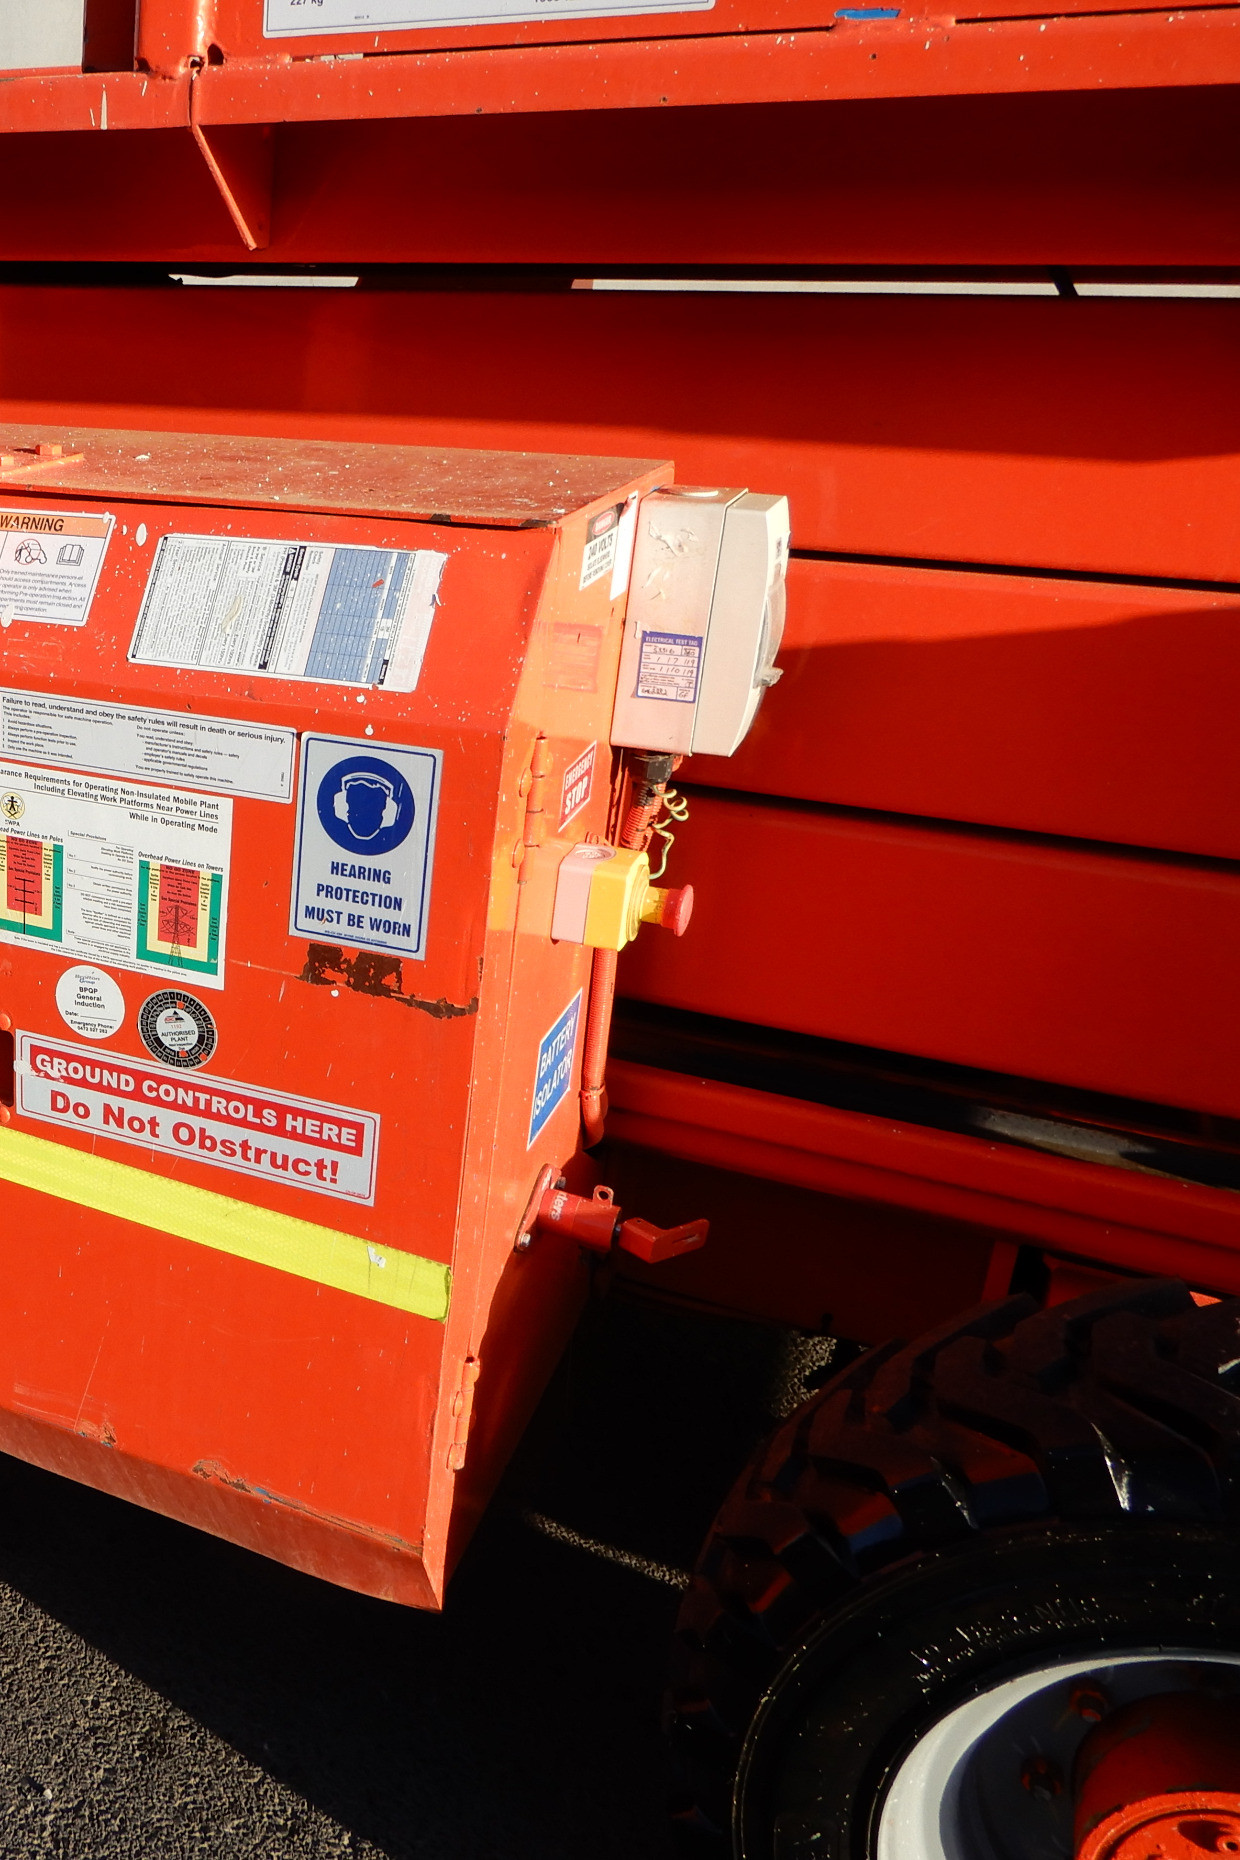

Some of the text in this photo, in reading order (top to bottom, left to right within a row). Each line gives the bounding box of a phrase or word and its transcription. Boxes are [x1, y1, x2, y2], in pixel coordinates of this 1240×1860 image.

[0, 514, 65, 532] WARNING
[2, 696, 23, 706] Failure
[24, 699, 30, 707] to
[32, 700, 47, 711] read,
[49, 702, 84, 714] understand
[85, 708, 97, 716] and
[99, 710, 114, 721] obey
[116, 712, 126, 721] the
[128, 714, 147, 725] safety
[148, 717, 165, 726] rules
[166, 719, 178, 728] will
[179, 721, 198, 731] result
[200, 724, 206, 732] in
[208, 725, 226, 735] death
[237, 730, 262, 740] serious
[264, 734, 285, 745] injury.
[565, 750, 593, 790] EMERGENCY
[24, 772, 70, 789] Requirements
[73, 779, 82, 788] for
[85, 781, 118, 796] Operating
[121, 787, 170, 803] Non-Insulated
[173, 795, 197, 807] Mobile
[200, 800, 219, 810] Plant
[34, 782, 218, 820] Including Elevating Work Platforms Near Power Lines
[565, 776, 588, 815] STOP
[10, 828, 26, 837] Power
[27, 831, 40, 839] Lines
[49, 834, 63, 843] Poles
[129, 812, 218, 834] While in Operating Mode
[138, 851, 163, 862] Overhead
[164, 856, 181, 865] Power
[182, 859, 196, 868] Lines
[206, 863, 223, 873] Towers
[331, 861, 391, 884] HEARING
[316, 883, 402, 911] PROTECTION
[304, 905, 343, 924] MUST
[347, 913, 364, 929] BE
[369, 917, 411, 938] WORN
[75, 1000, 105, 1009] Induction
[76, 993, 102, 1001] General
[540, 1012, 576, 1079] BATTERY
[35, 1054, 357, 1148] GROUND CONTROLS HERE
[532, 1049, 572, 1120] ISOLATOR
[50, 1090, 339, 1185] Do Not Obstruct!
